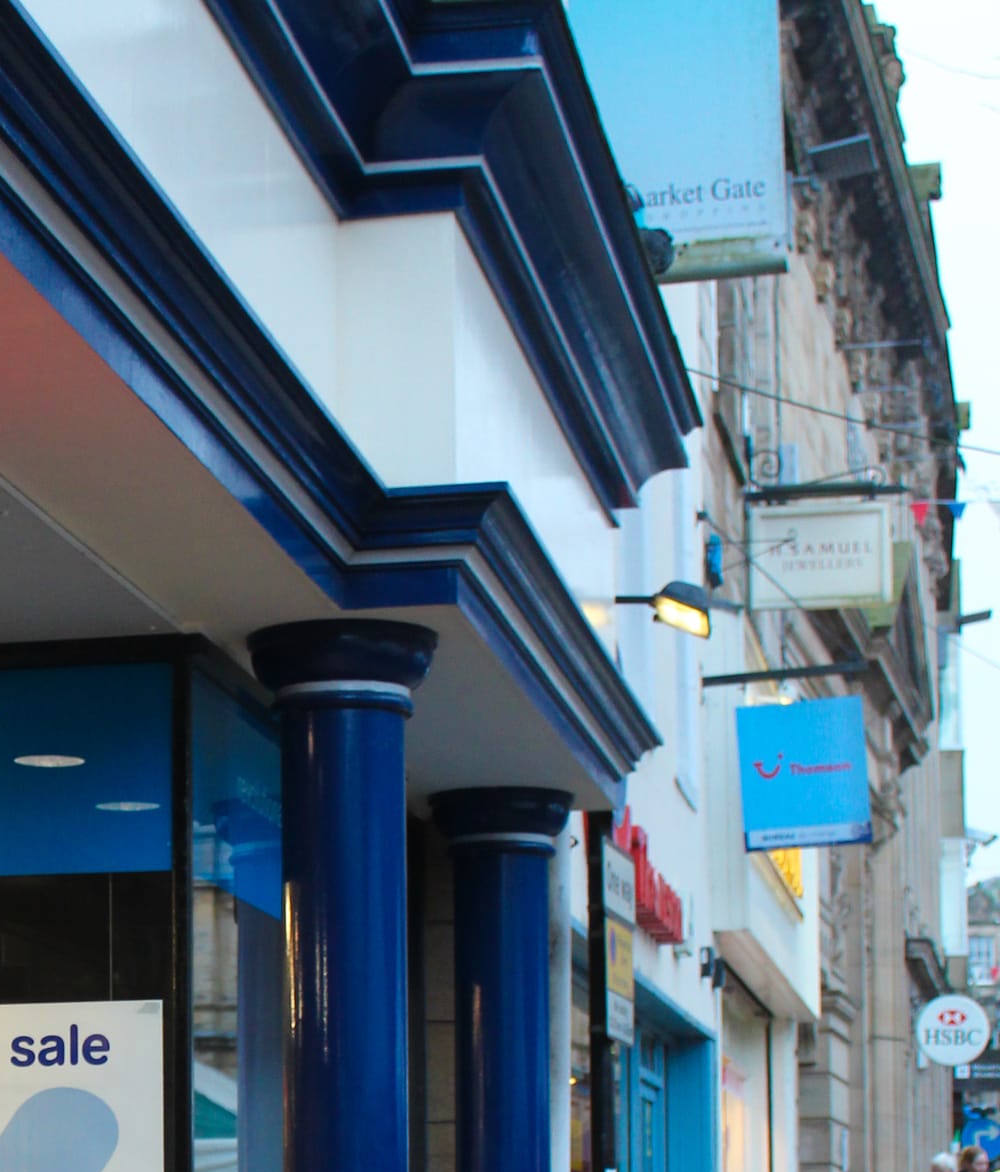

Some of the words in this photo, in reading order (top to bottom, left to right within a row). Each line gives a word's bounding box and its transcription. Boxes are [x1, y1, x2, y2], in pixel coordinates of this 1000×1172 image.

[645, 183, 703, 207] arket
[711, 178, 766, 201] Gate
[790, 542, 872, 556] SAMUEL
[10, 1024, 110, 1068] sale
[924, 1029, 982, 1046] HSBC
